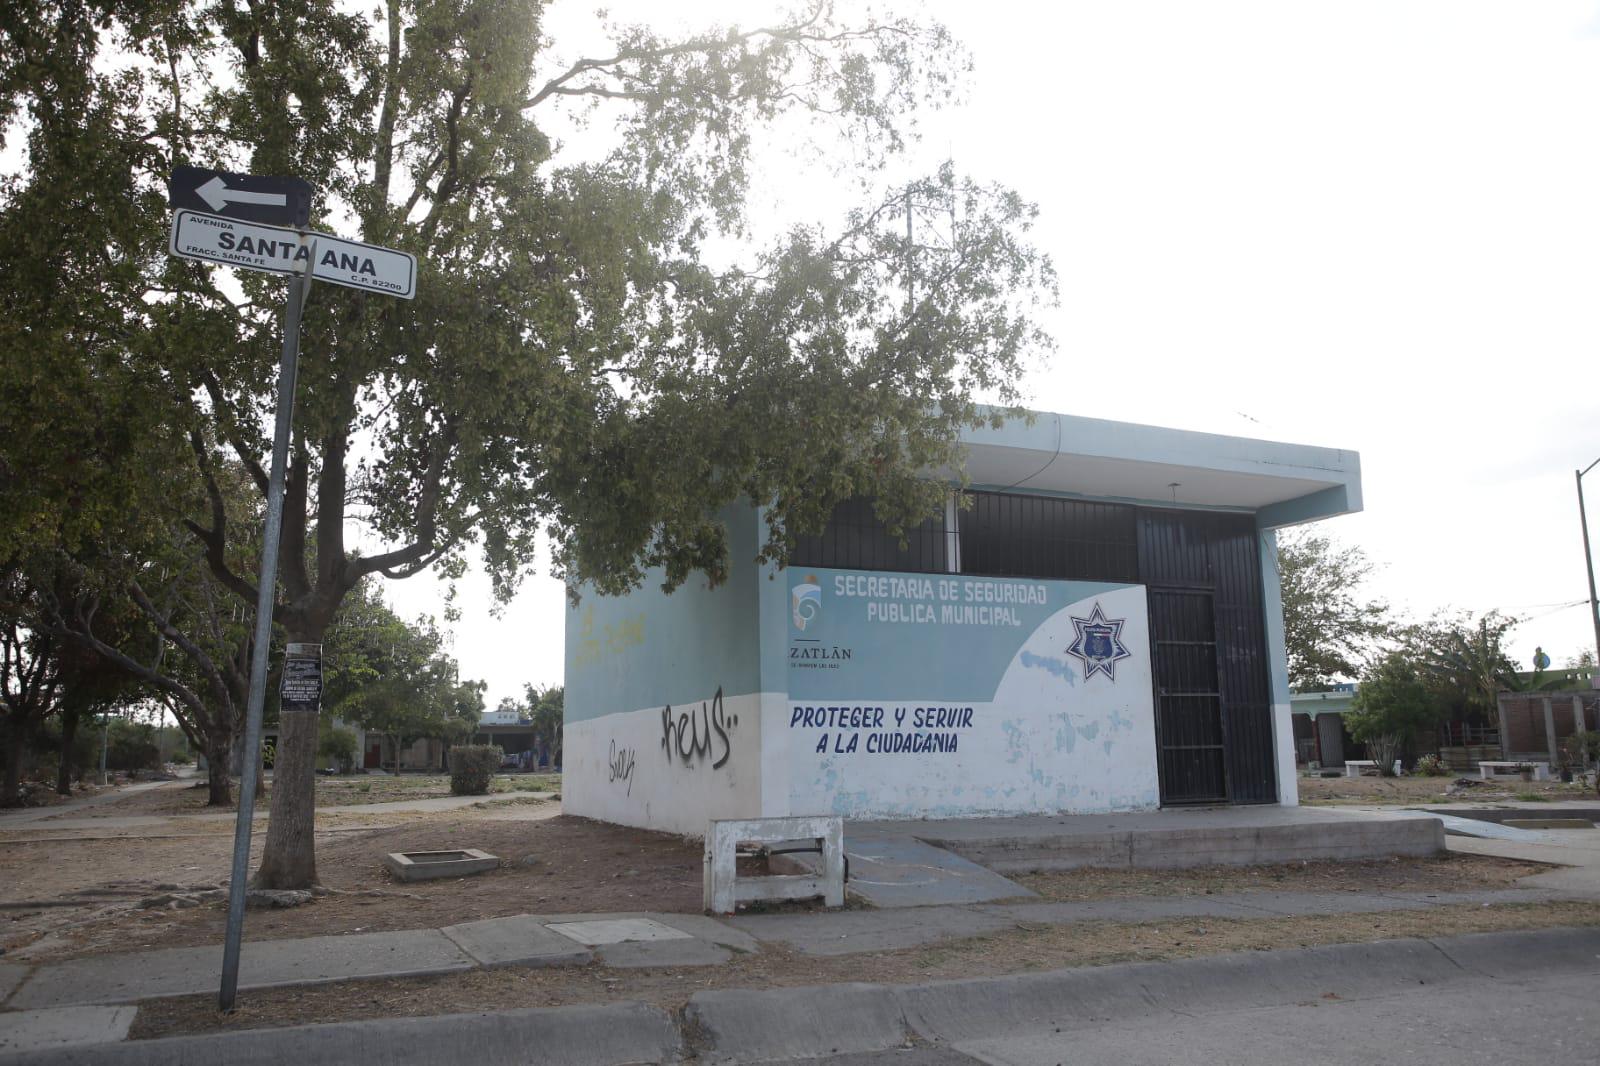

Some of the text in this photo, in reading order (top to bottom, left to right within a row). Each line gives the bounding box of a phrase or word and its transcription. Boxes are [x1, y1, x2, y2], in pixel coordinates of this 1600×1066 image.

[189, 216, 234, 231] AVENIDA
[186, 244, 266, 266] FRACC. SANTA FE
[217, 231, 377, 277] SANTA ANA
[351, 275, 402, 291] C.P. 82200
[834, 575, 1048, 605] SECRETARIA DE SEGURIDAD
[867, 602, 1022, 627] PUBLICA MUNICIPAL
[790, 706, 974, 728] PROTEGER Y SERVIR
[815, 733, 958, 754] A LA CIUDADANIA
